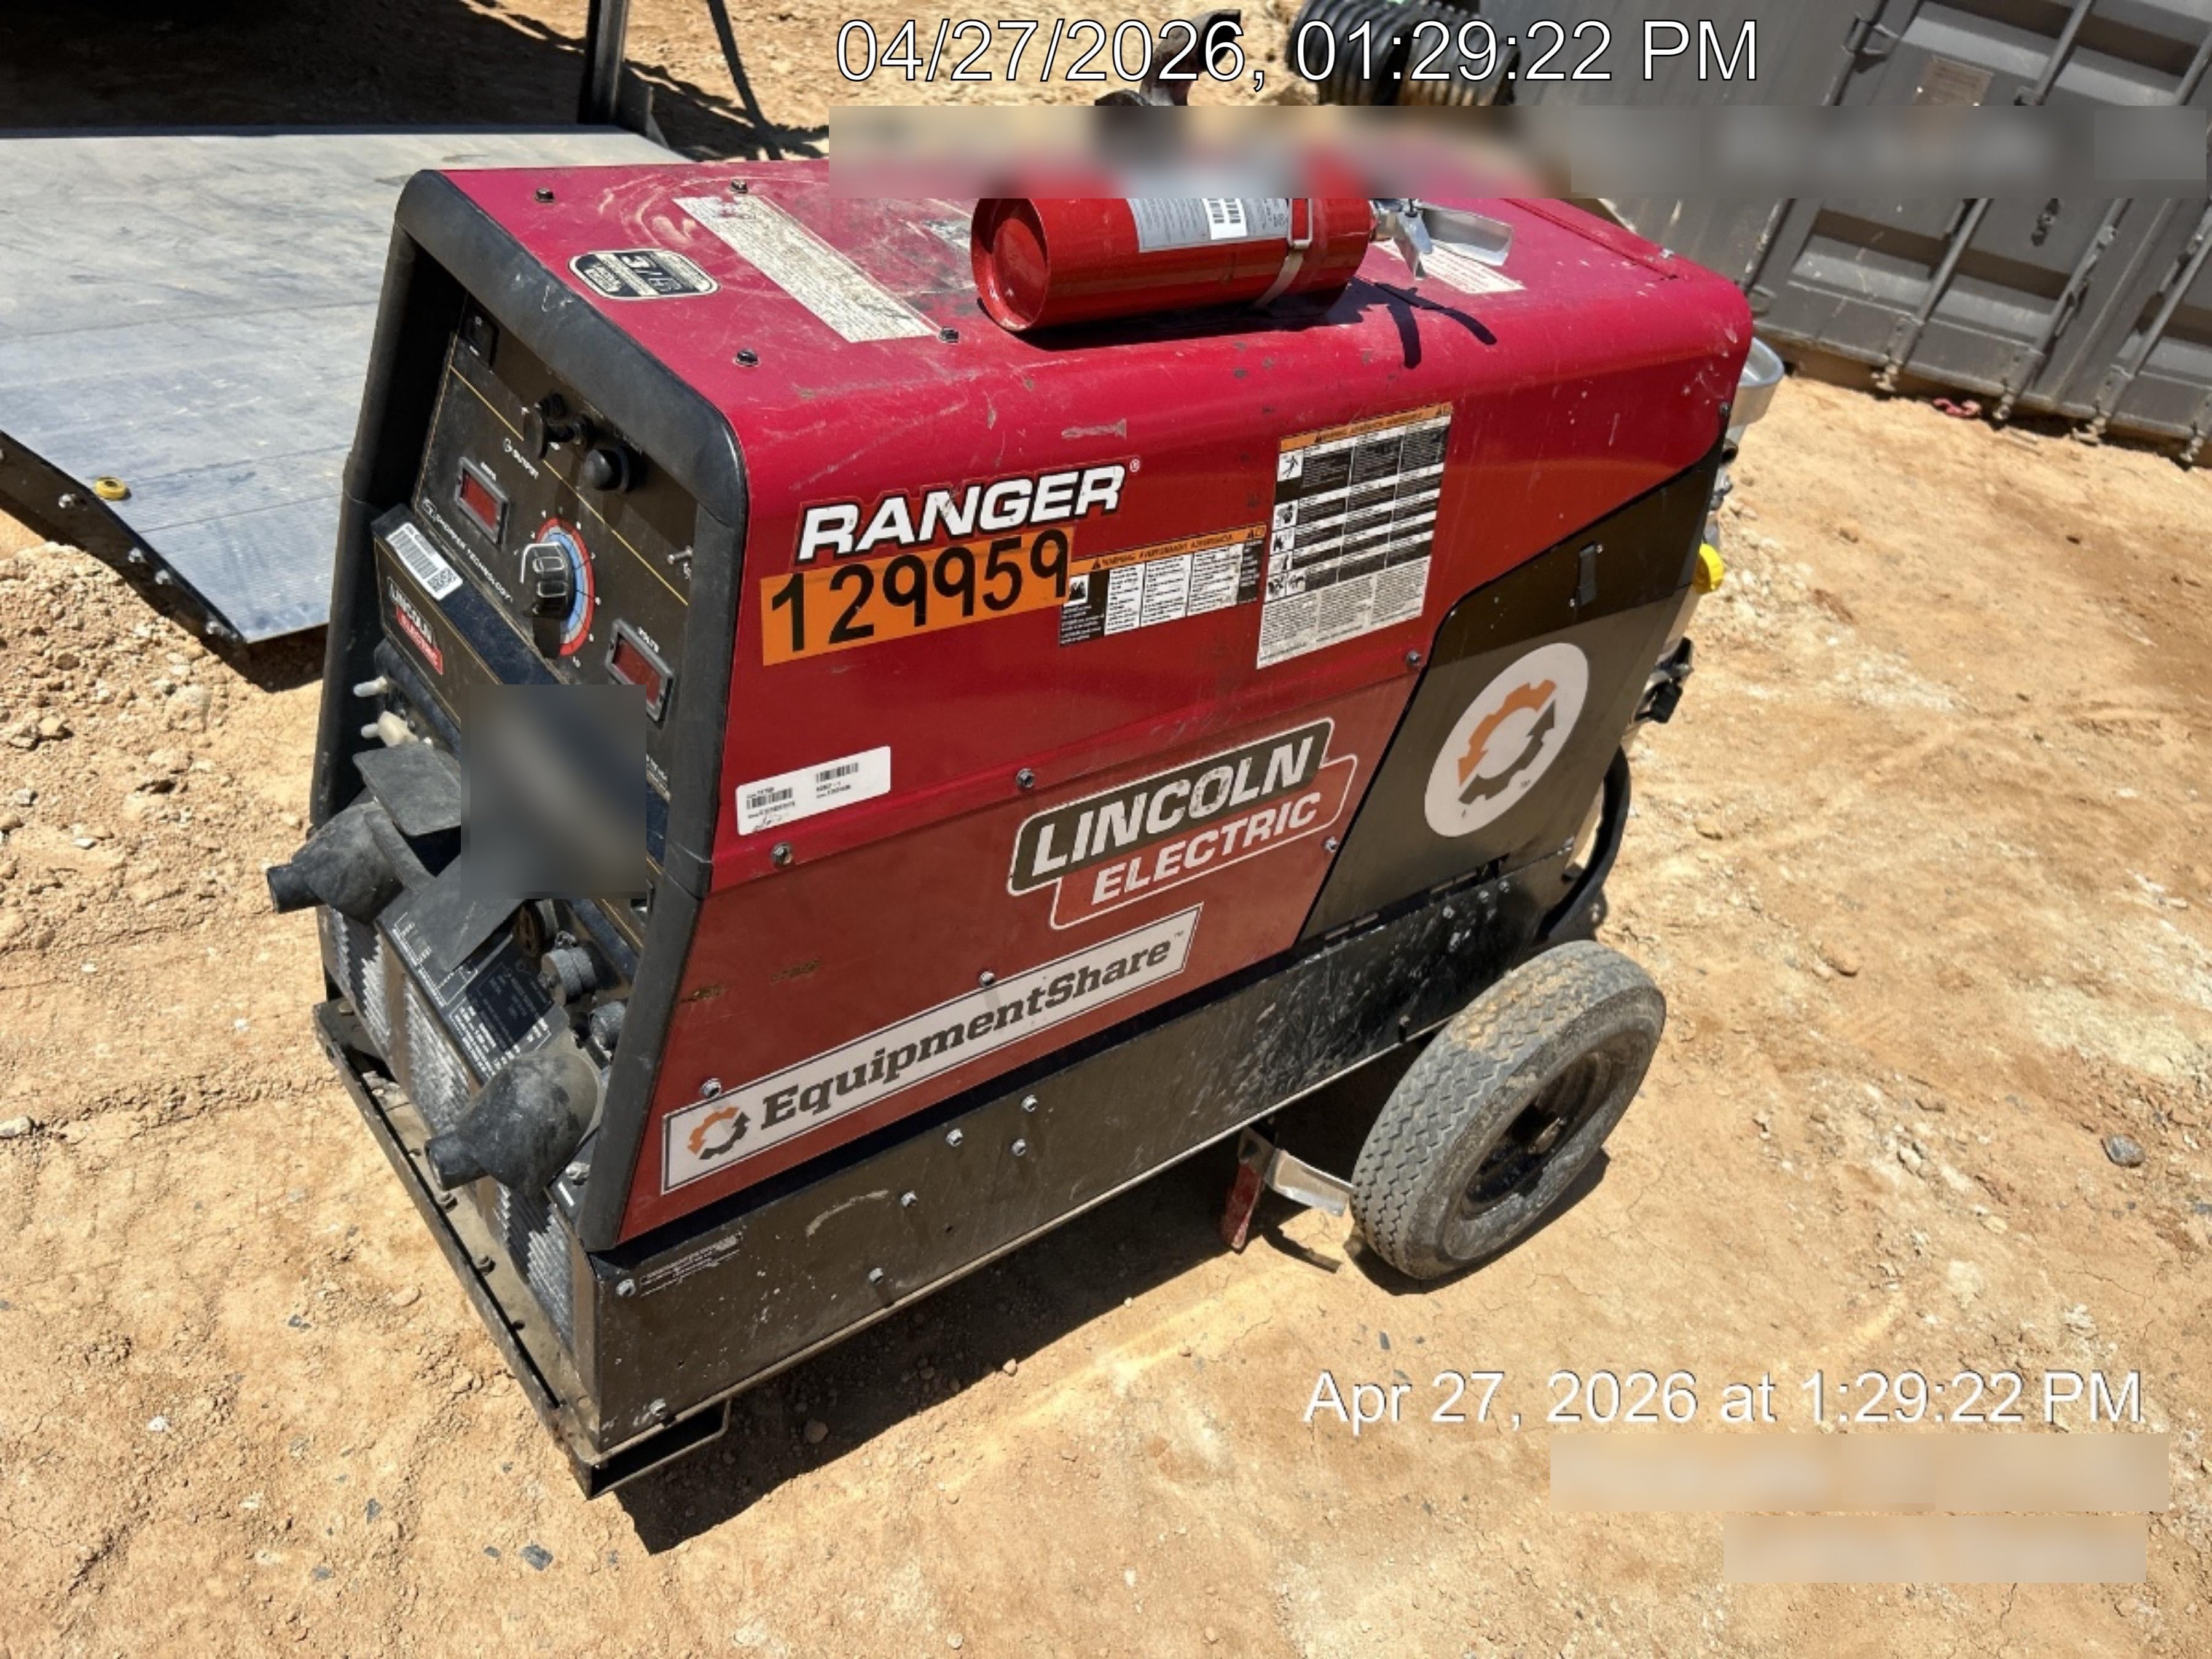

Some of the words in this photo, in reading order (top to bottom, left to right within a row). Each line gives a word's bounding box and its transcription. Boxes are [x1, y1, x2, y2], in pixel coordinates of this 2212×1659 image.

[771, 528, 1069, 651] 129959
[1031, 735, 1314, 877] LINCOLN
[1091, 791, 1321, 906] ELECTRIC
